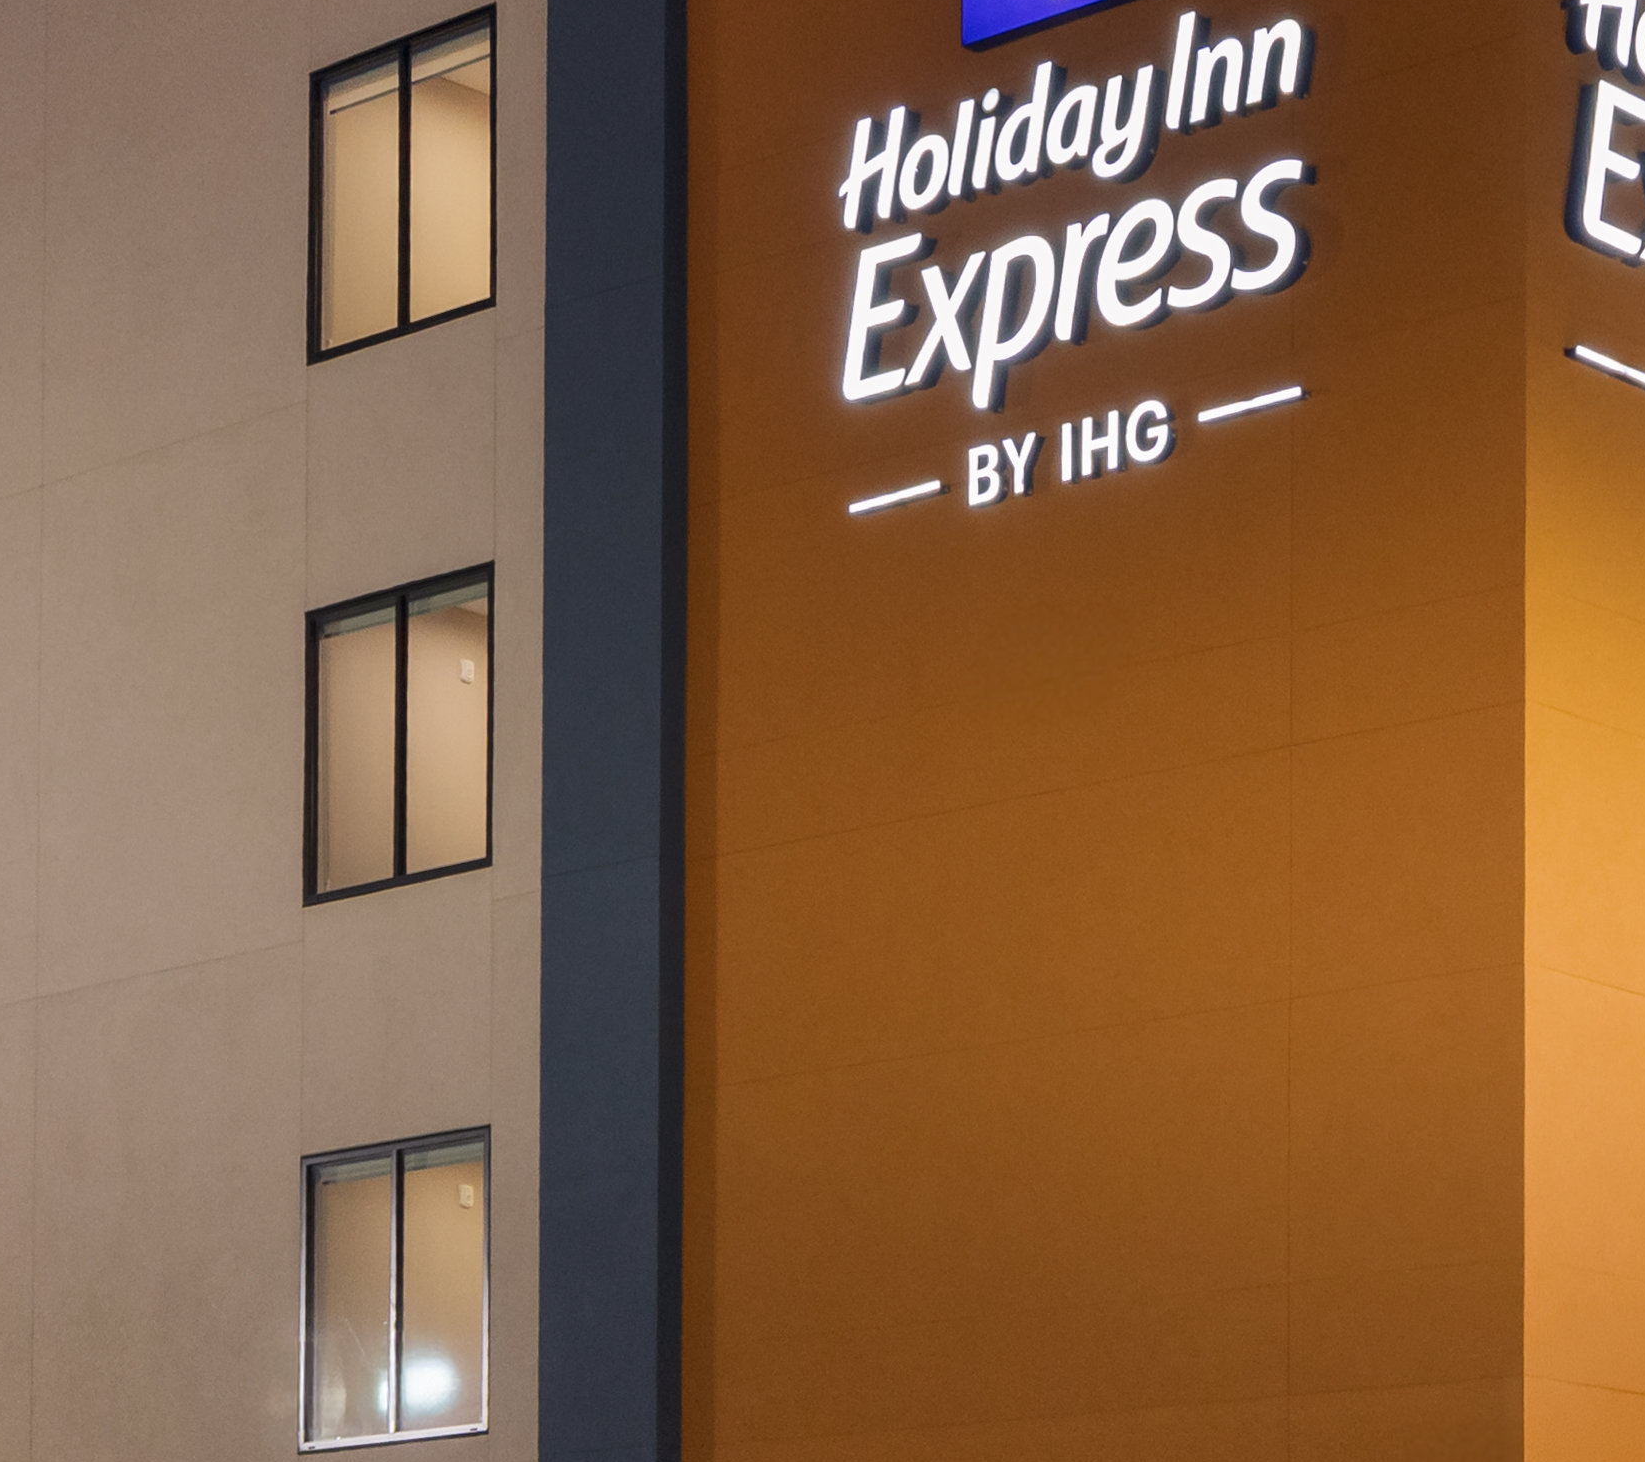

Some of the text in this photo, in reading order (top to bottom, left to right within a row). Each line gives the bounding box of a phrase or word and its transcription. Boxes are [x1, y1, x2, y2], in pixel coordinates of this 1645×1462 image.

[837, 10, 1303, 230] Holiday Inn
[841, 158, 1304, 410] Express
[967, 398, 1170, 507] BY IHG
